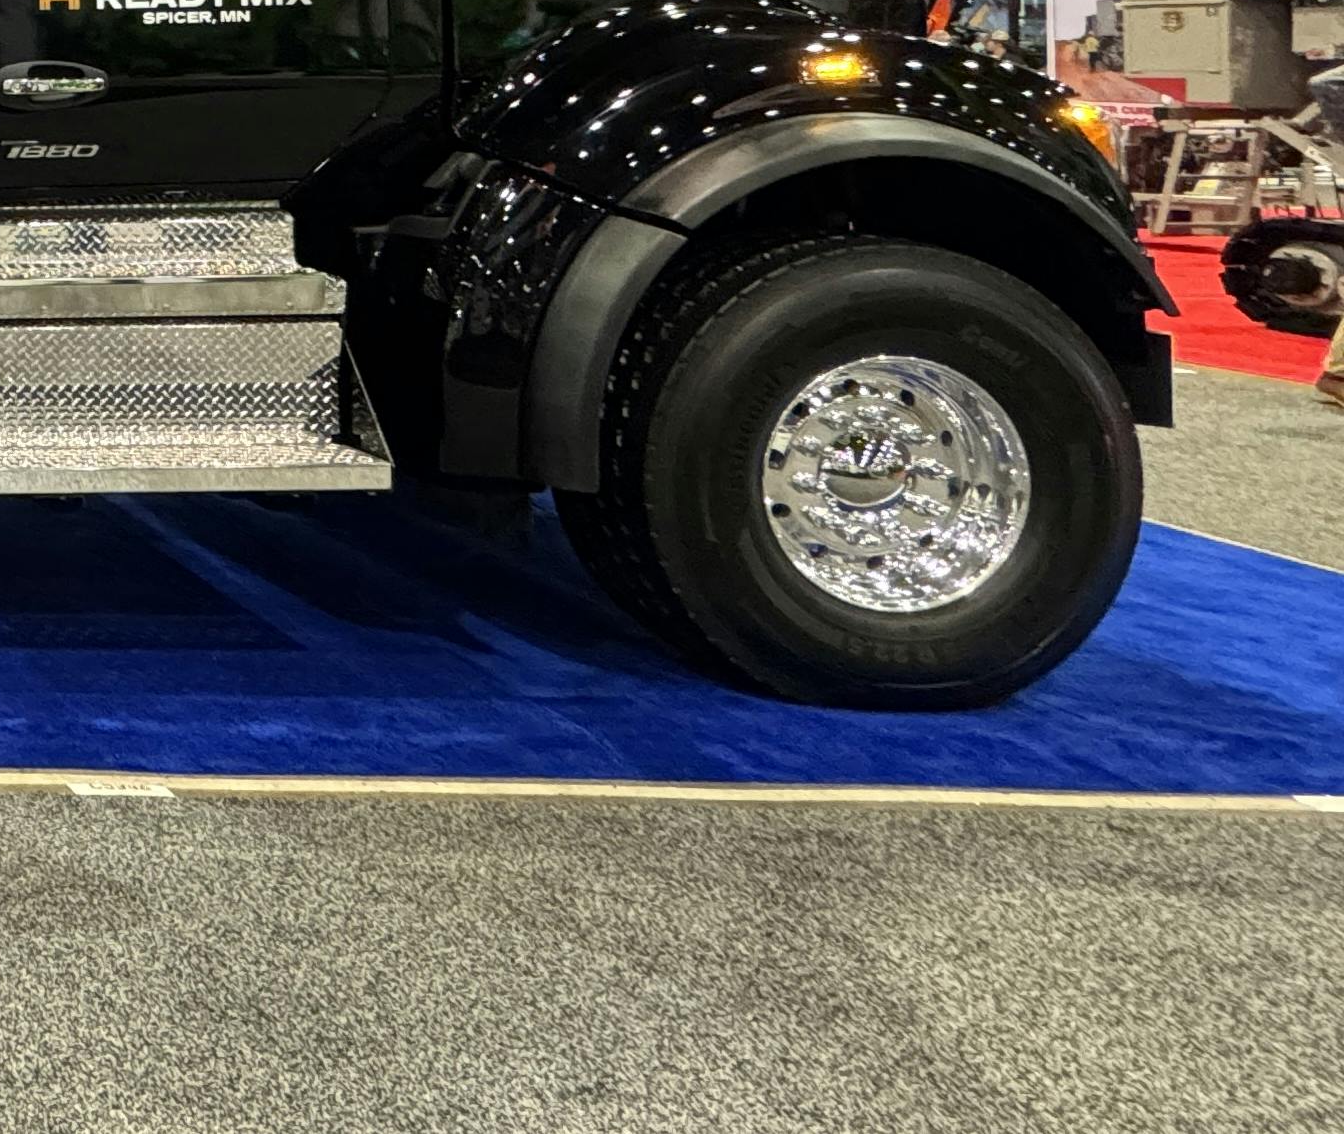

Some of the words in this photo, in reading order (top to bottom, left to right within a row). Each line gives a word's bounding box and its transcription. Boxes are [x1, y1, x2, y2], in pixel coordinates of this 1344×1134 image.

[142, 11, 217, 25] SPICER,
[220, 10, 251, 23] MN
[1, 140, 99, 159] T880
